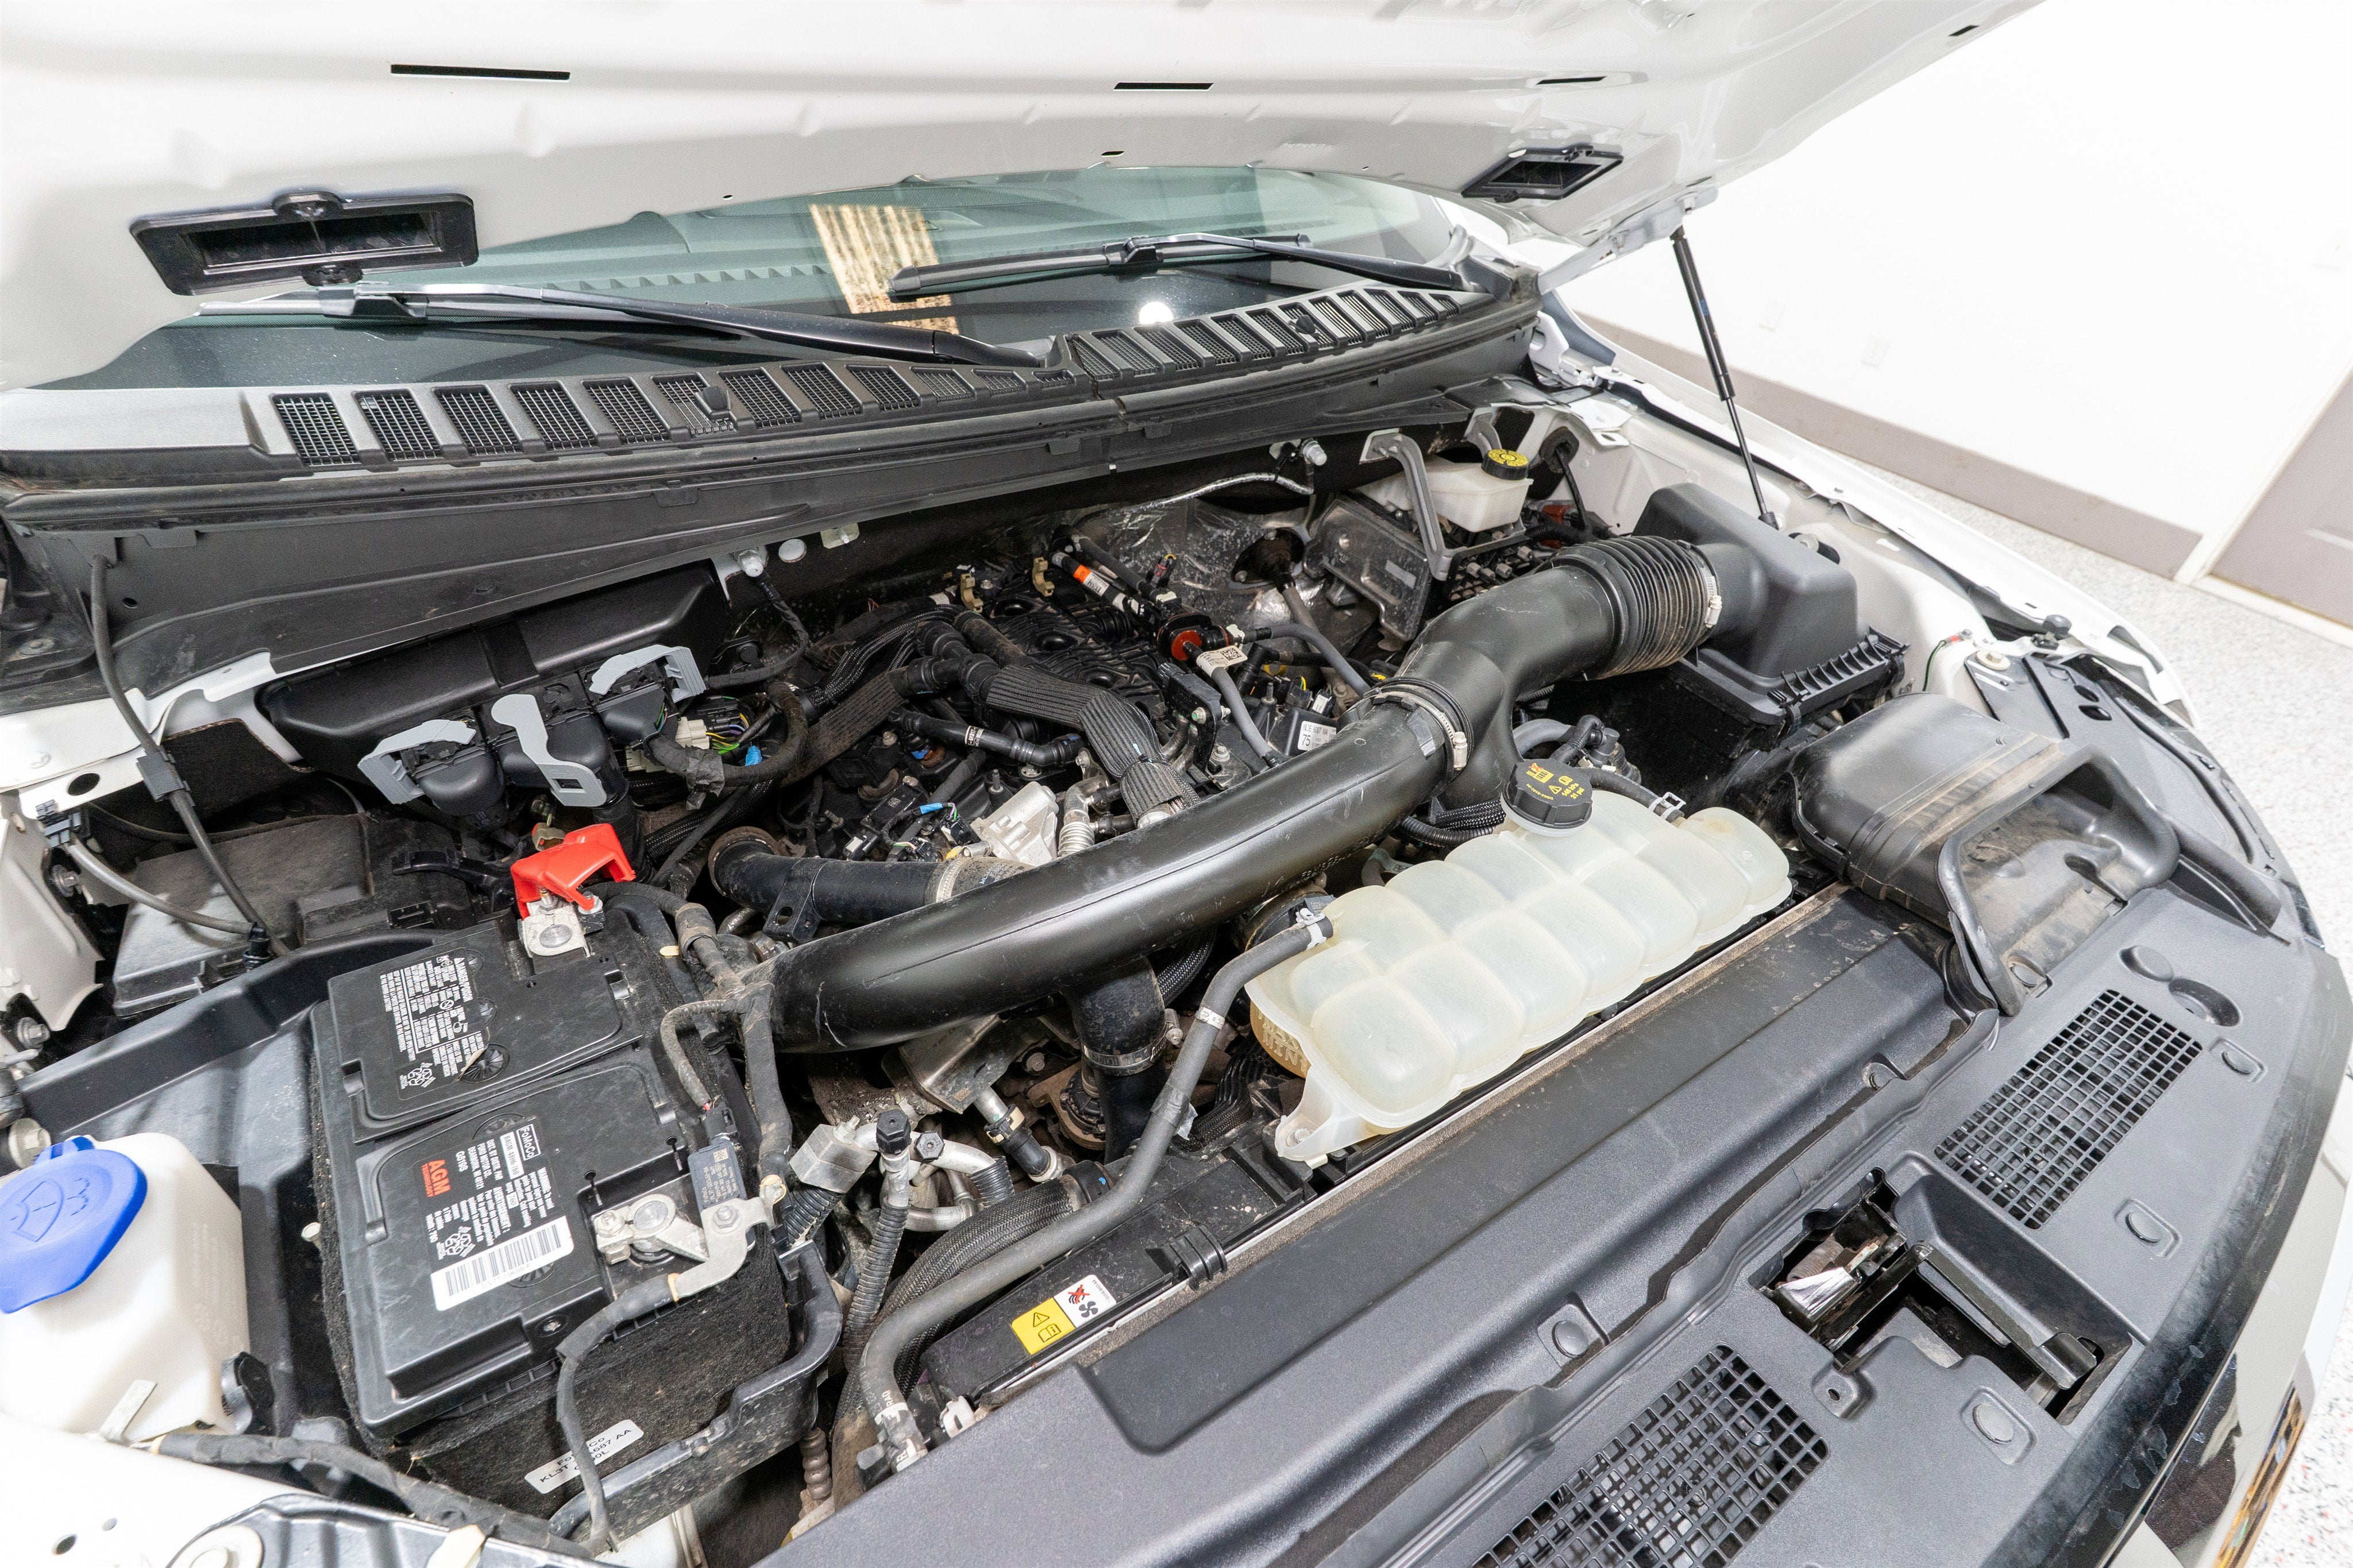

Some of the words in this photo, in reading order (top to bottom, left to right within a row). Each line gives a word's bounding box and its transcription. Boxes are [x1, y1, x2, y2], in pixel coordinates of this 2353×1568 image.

[1302, 735, 1311, 746] 75
[456, 962, 473, 1002] DANGER/POISON
[1263, 1030, 1297, 1065] MIN
[519, 1126, 535, 1157] FoMoCo
[422, 1164, 434, 1197] TECHNOLOGY
[428, 1160, 450, 1195] AGM
[508, 1194, 516, 1206] 760
[540, 1464, 569, 1482] KL3T
[616, 1428, 632, 1440] AA
